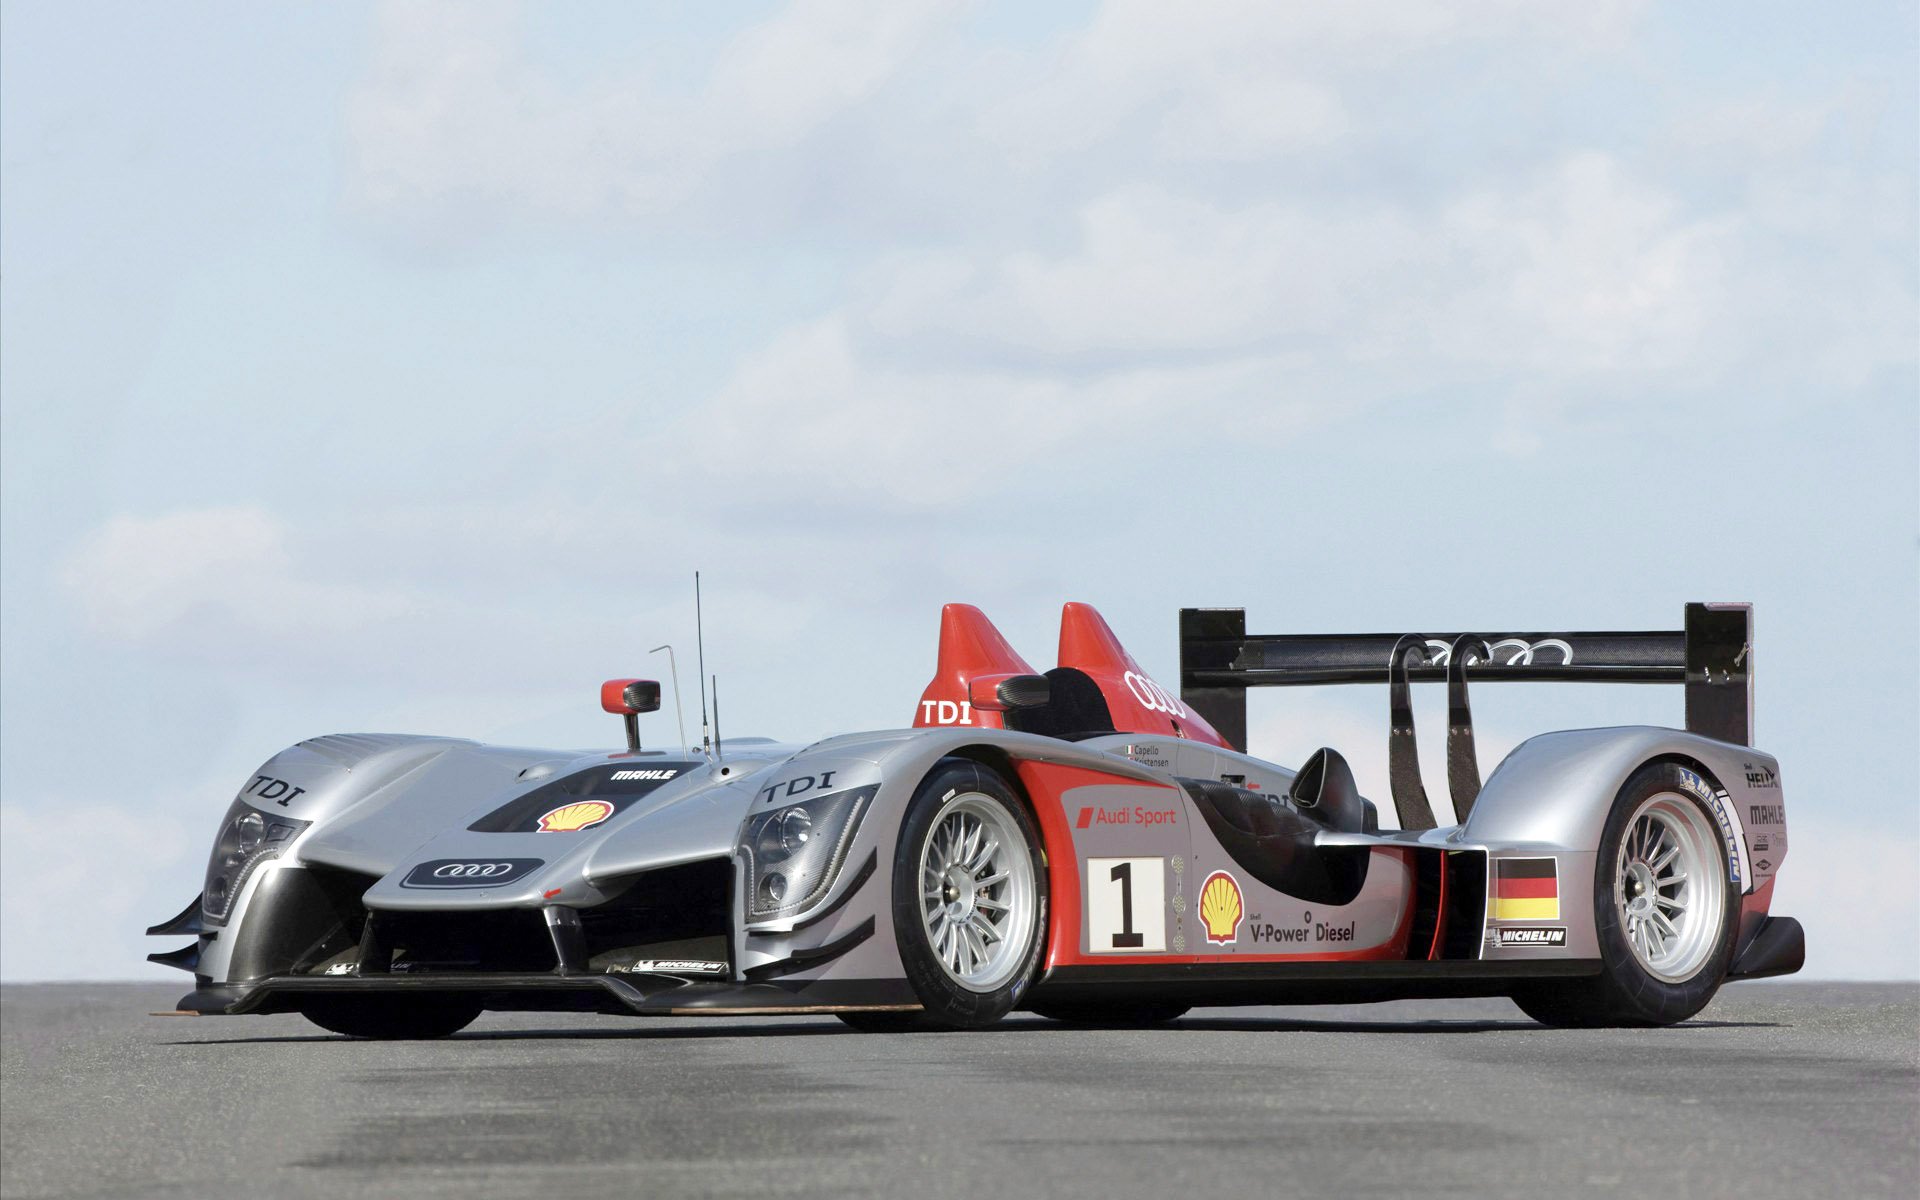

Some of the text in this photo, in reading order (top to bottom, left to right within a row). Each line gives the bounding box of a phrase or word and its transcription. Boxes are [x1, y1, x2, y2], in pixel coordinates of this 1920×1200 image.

[922, 700, 972, 724] TDI
[1134, 745, 1159, 756] Capello
[610, 770, 677, 780] MAHLE
[1745, 772, 1779, 788] HELIX
[246, 775, 306, 807] TDI
[762, 771, 836, 803] TDI
[1096, 807, 1176, 827] Audi Sport
[1750, 805, 1784, 824] MAHLE
[1697, 780, 1740, 879] MICHELIN
[1111, 862, 1143, 947] 1
[1250, 921, 1355, 942] V-Power Diesel
[1502, 931, 1564, 941] MICHELIN
[655, 961, 722, 969] MICHELIN
